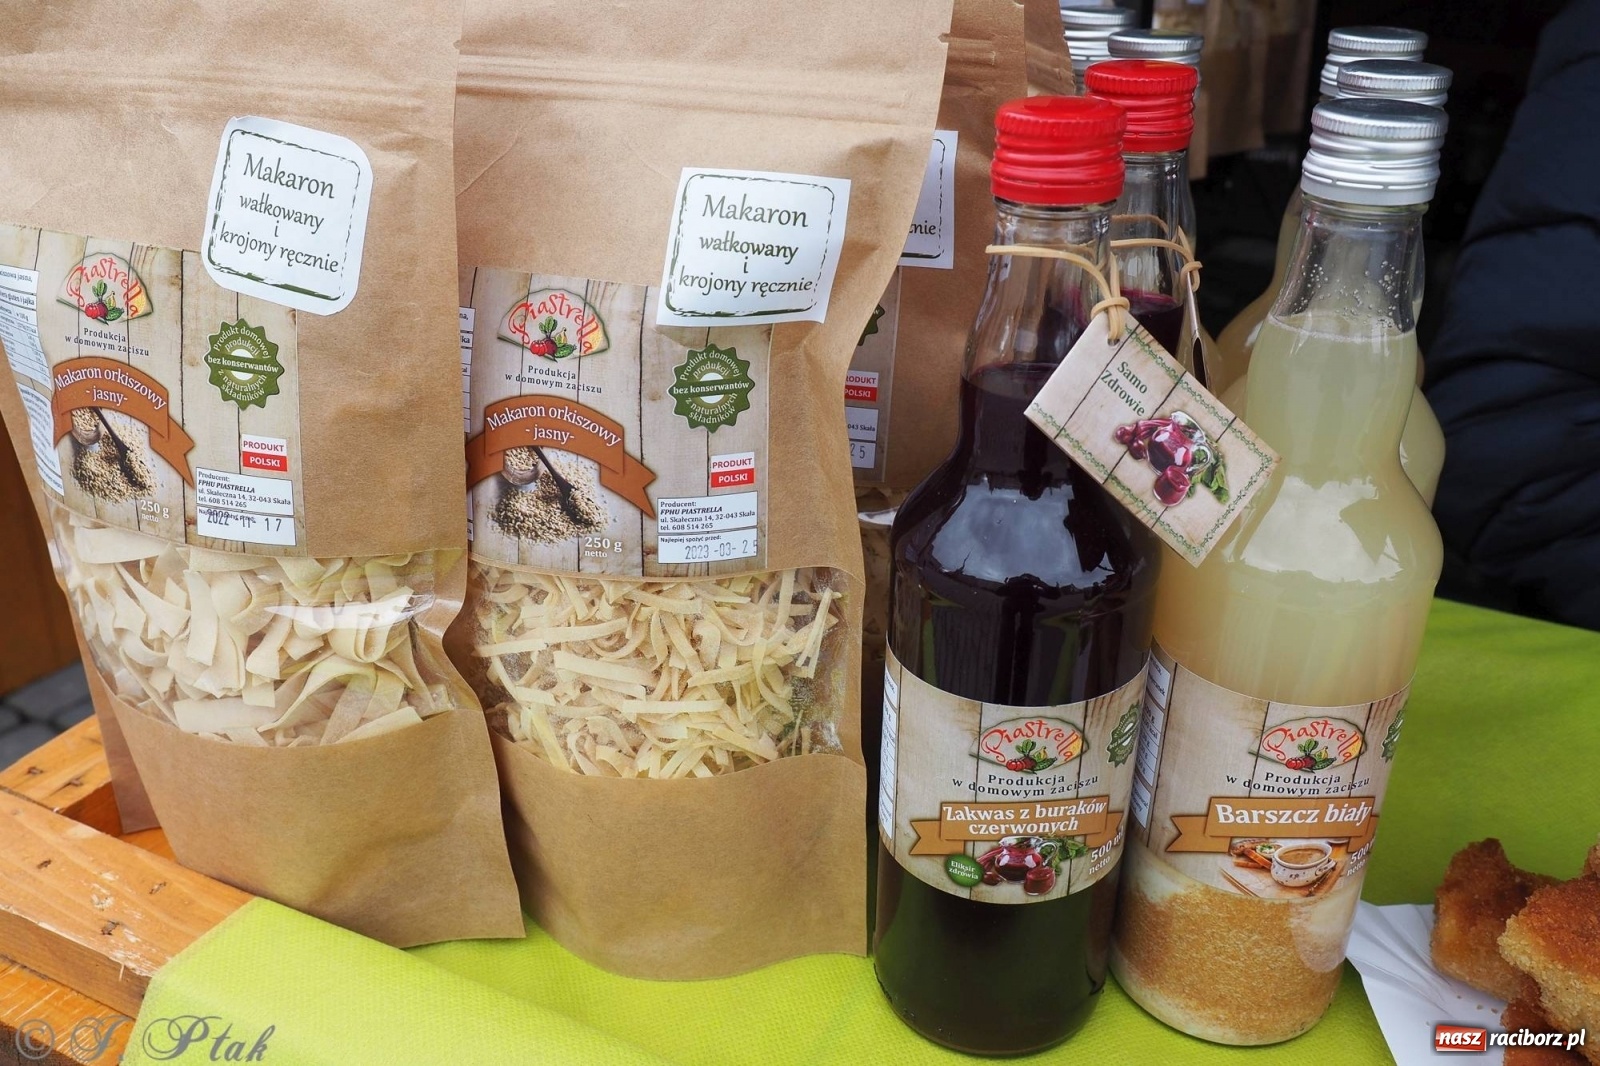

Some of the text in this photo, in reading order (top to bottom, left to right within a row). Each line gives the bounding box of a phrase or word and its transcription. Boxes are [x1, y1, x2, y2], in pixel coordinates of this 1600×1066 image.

[243, 153, 334, 198] Makaron
[240, 192, 324, 234] wałkowany
[702, 193, 809, 227] Makaron
[274, 220, 280, 237] i
[219, 221, 338, 273] krojony ręcznie
[699, 231, 799, 265] wałkowany
[743, 256, 749, 274] i
[679, 265, 813, 298] krojony ręcznie
[84, 327, 126, 343] Produkcja
[73, 335, 115, 350] domowym
[118, 344, 149, 356] zaciszu
[225, 337, 260, 356] produkcji
[208, 355, 279, 373] bez konserwantów
[528, 365, 576, 380] Produkcja
[692, 361, 731, 380] produkcji
[223, 374, 267, 392] naturalnych
[515, 373, 563, 388] domowym
[566, 382, 602, 394] zaciszu
[1117, 361, 1147, 394] Samo
[54, 367, 167, 410] Makaron orkiszowy
[673, 381, 749, 395] bez konserwantów
[1101, 370, 1145, 416] Zdrowie
[690, 392, 738, 415] naturalnych
[486, 405, 622, 447] Makaron orkiszowy
[243, 440, 284, 452] PRODUKT
[249, 456, 281, 467] POLSKI
[712, 458, 752, 469] PRODUKT
[198, 470, 230, 482] Producent:
[718, 473, 748, 484] POLSKI
[198, 480, 255, 493] FPHU PIASTRELLA
[209, 497, 221, 505] 608
[222, 498, 233, 506] 514
[235, 500, 247, 508] 265
[249, 495, 272, 504] 32-043
[140, 499, 169, 519] 250 g
[681, 506, 723, 515] PIASTRELLA
[715, 512, 738, 520] 32-043
[584, 536, 622, 553] 250 g
[685, 544, 709, 560] 2023
[584, 550, 608, 558] netto
[952, 775, 1098, 799] w domowym zaciszu
[988, 774, 1065, 787] Produkcja
[1226, 775, 1370, 797] w domowym zaciszu
[1265, 772, 1341, 786] Produkcja
[943, 799, 1107, 821] Zakwas z buraków
[1215, 801, 1372, 826] Barszcz biały
[968, 817, 1079, 835] czerwonych
[1091, 840, 1112, 863] 500
[949, 867, 979, 880] zdrowia
[951, 860, 975, 872] Eliksir
[1089, 856, 1110, 875] netto
